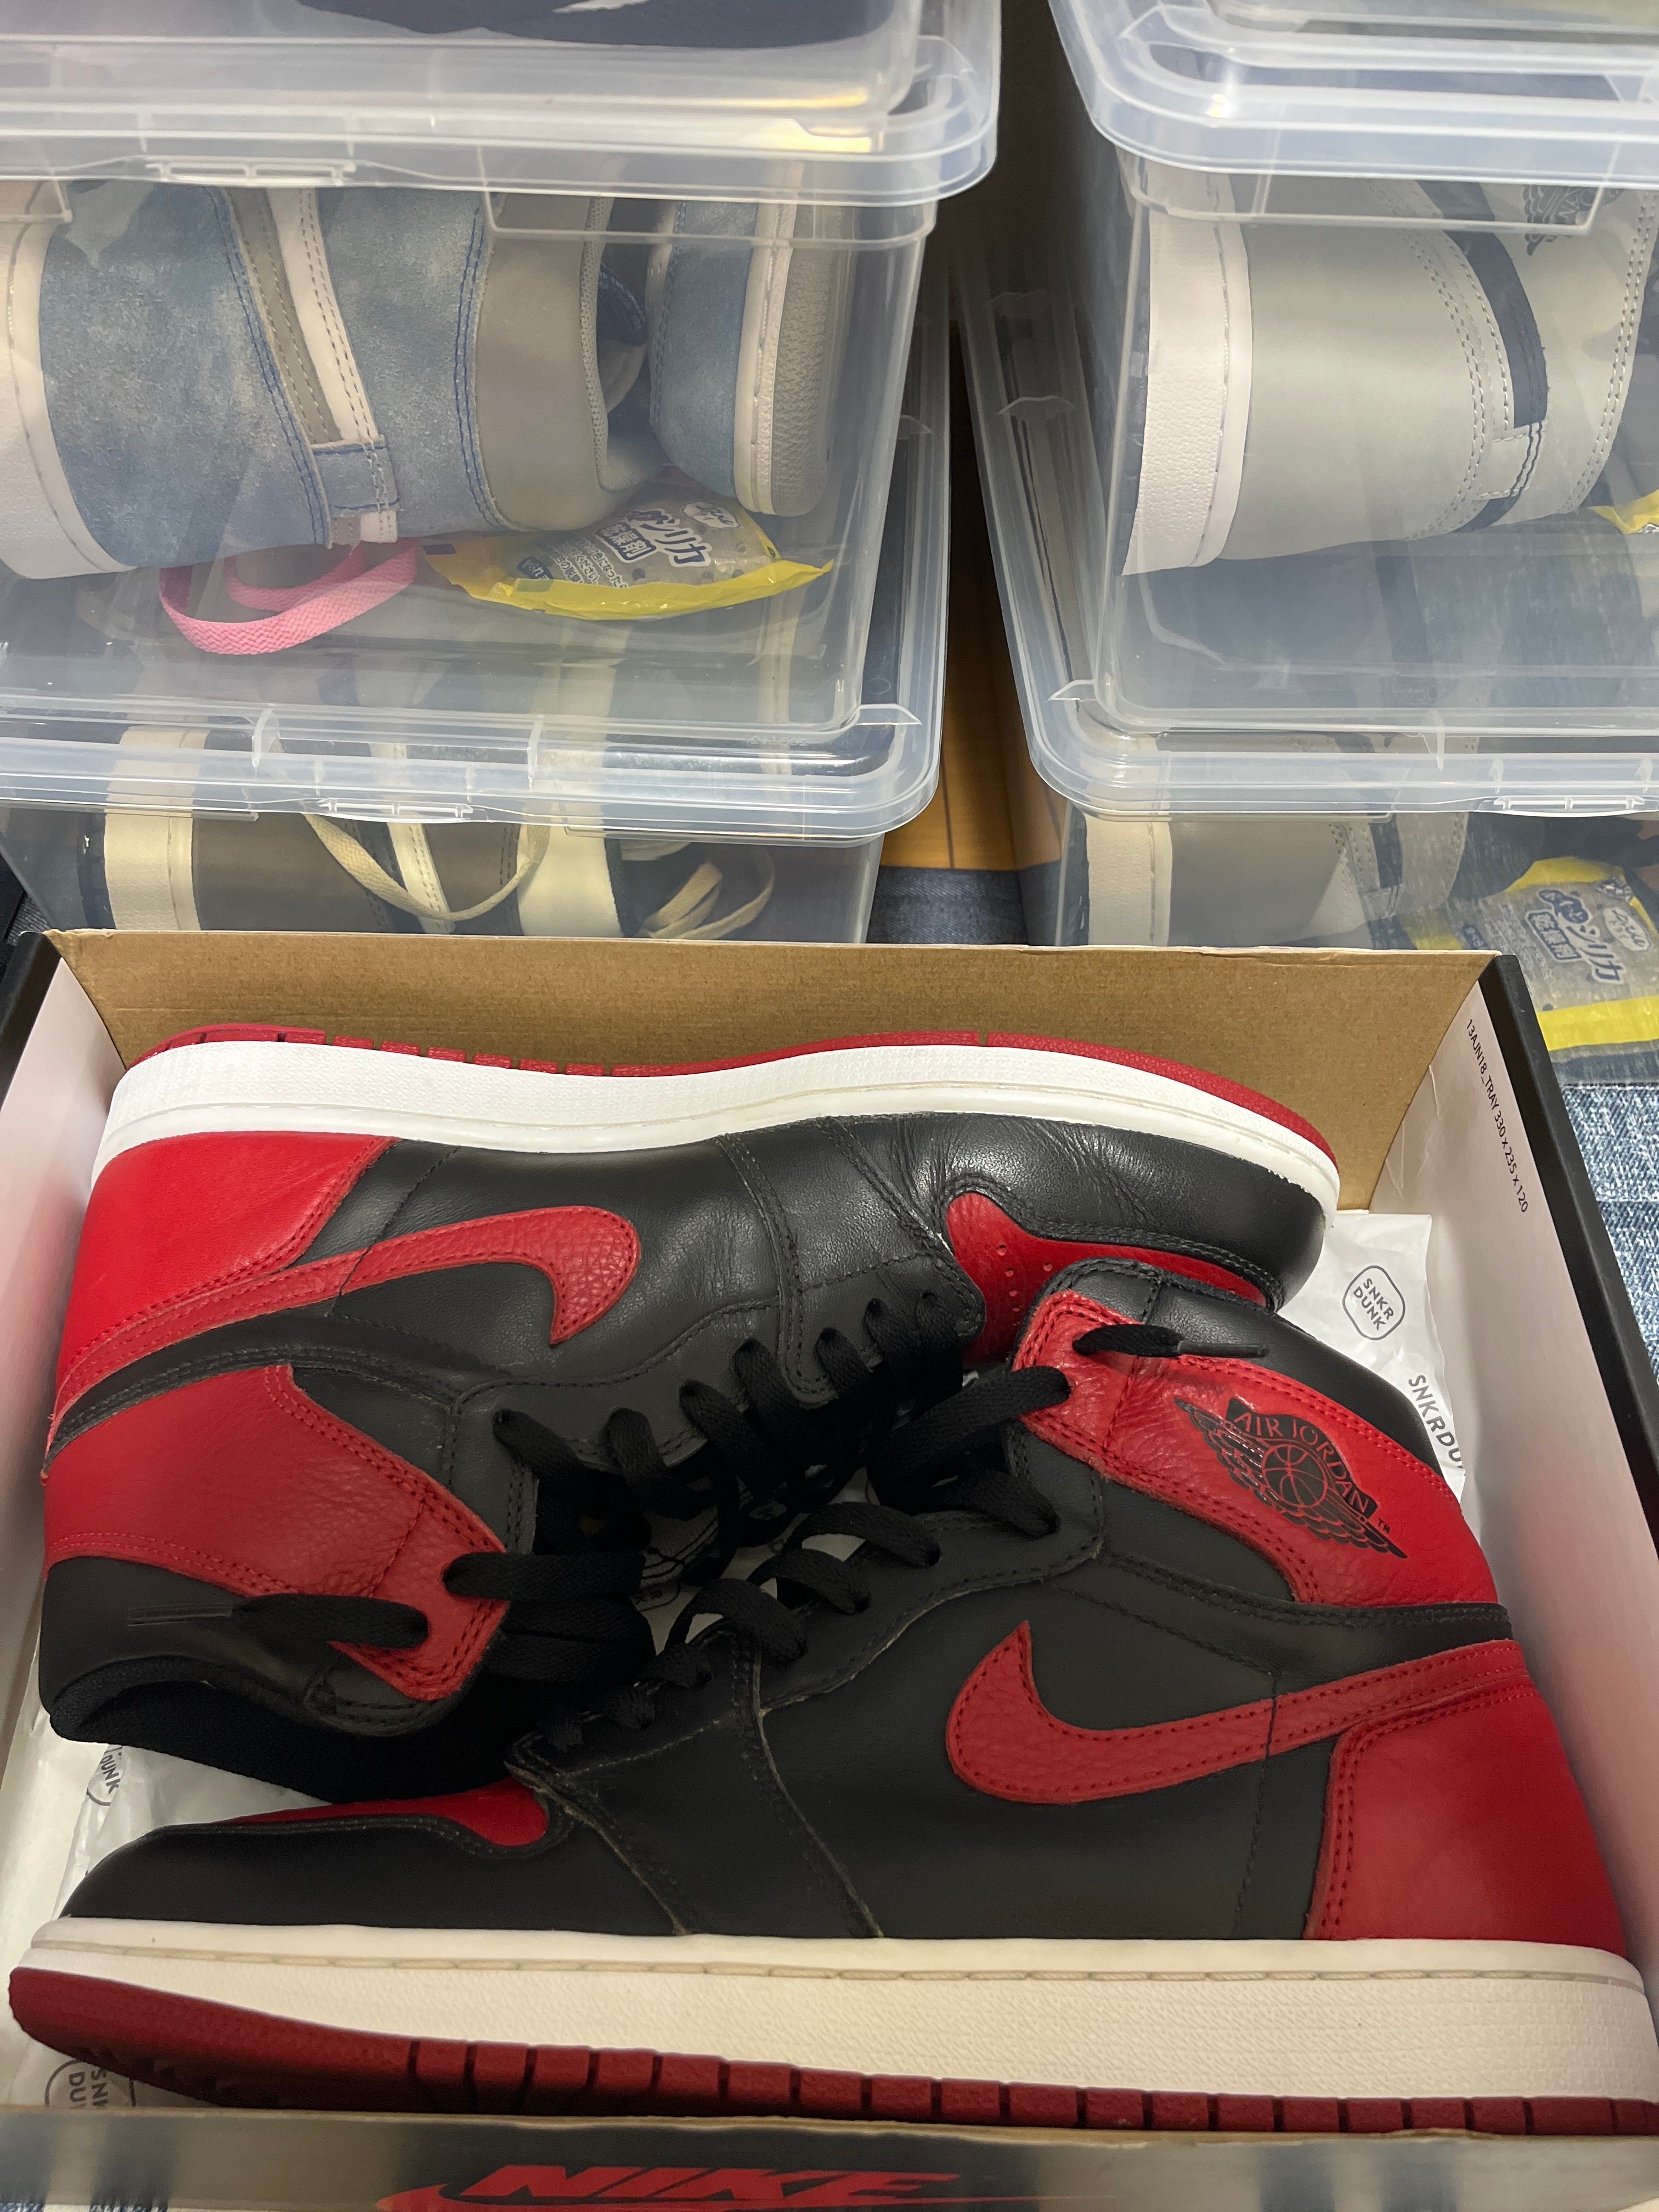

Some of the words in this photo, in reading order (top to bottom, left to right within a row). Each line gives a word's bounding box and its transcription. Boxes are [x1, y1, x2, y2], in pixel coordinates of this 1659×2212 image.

[1466, 1019, 1499, 1110] 13AJN18_TRAY
[1494, 1110, 1506, 1137] 330
[1505, 1147, 1517, 1175] 235
[1516, 1185, 1528, 1212] 120
[1353, 1285, 1386, 1331] DUNK
[1363, 1278, 1394, 1320] SNKR
[1408, 1374, 1465, 1470] SNKRDU
[1234, 1412, 1283, 1438] AIR
[1293, 1418, 1369, 1514] JORDAN
[69, 2071, 87, 2108] DU
[91, 2068, 109, 2106] SN
[460, 2164, 962, 2198] NIKE
